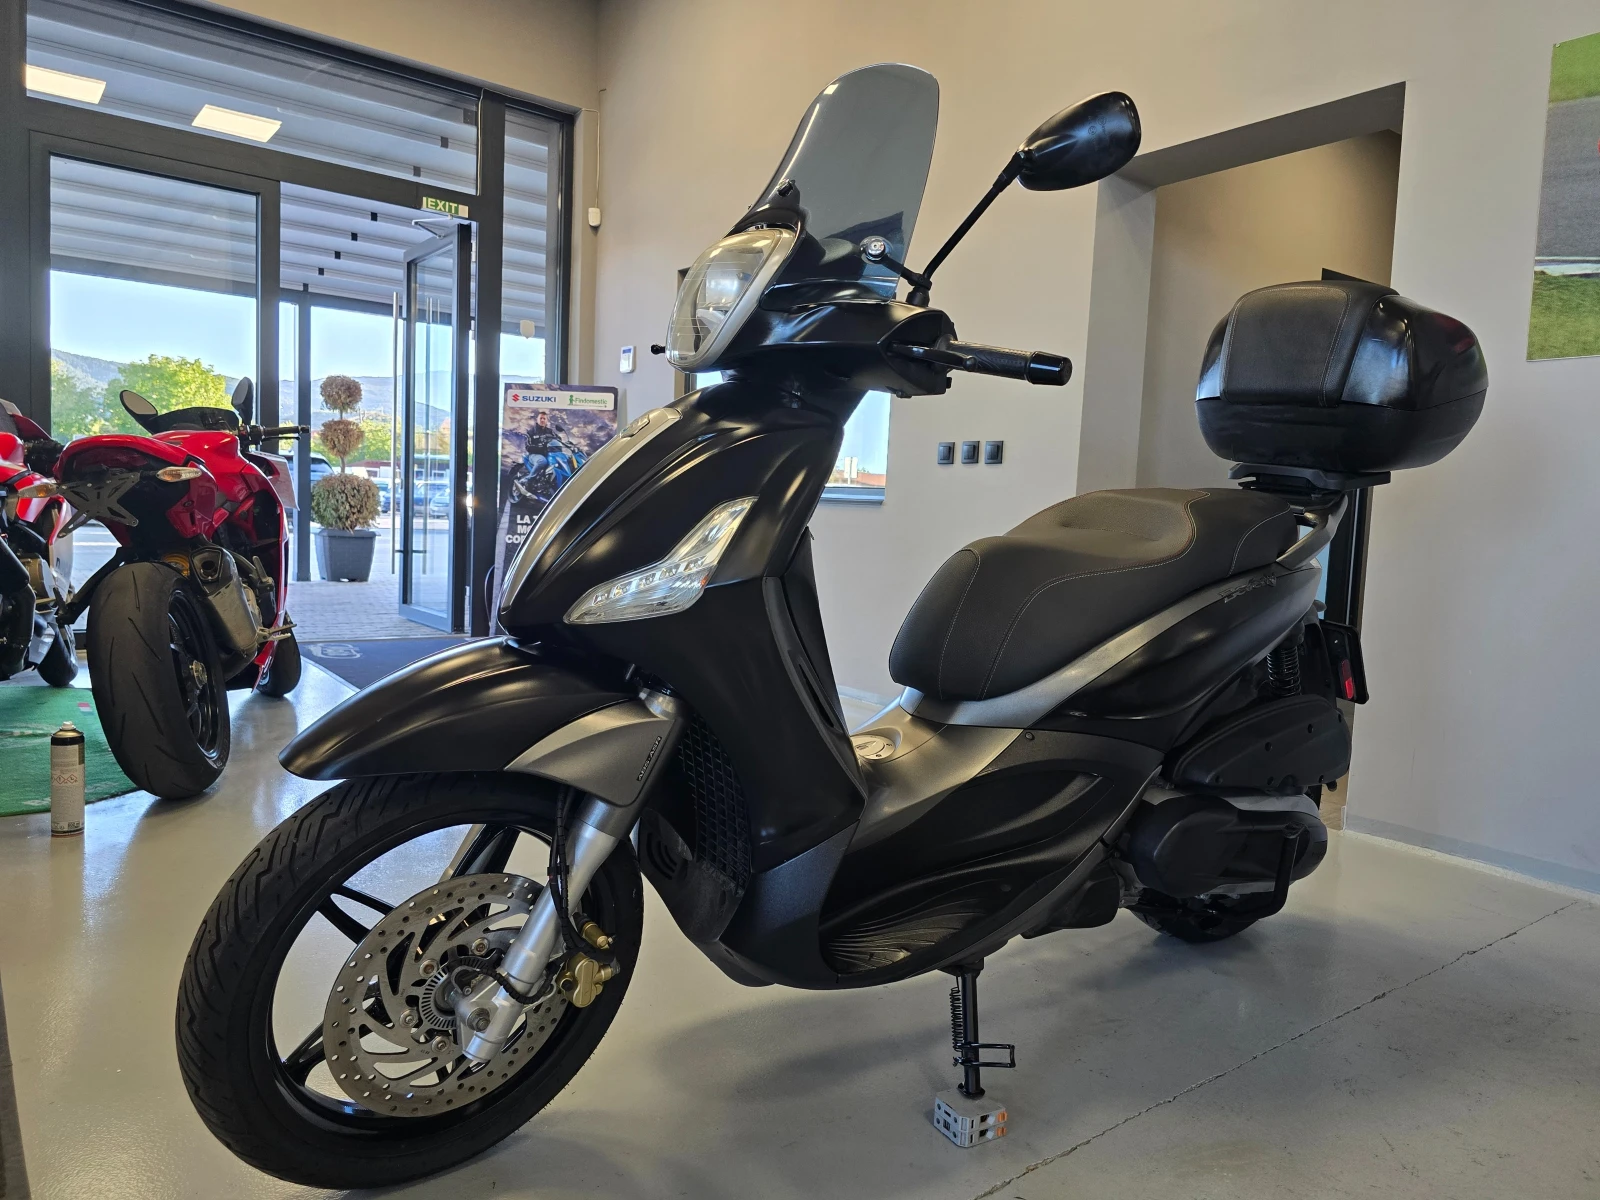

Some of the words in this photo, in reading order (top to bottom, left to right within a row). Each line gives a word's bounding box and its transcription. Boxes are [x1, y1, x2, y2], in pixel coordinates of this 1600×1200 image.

[427, 197, 458, 214] EXIT
[522, 395, 557, 403] SUZUKI
[575, 397, 608, 405] Findomestic
[516, 514, 531, 524] LA
